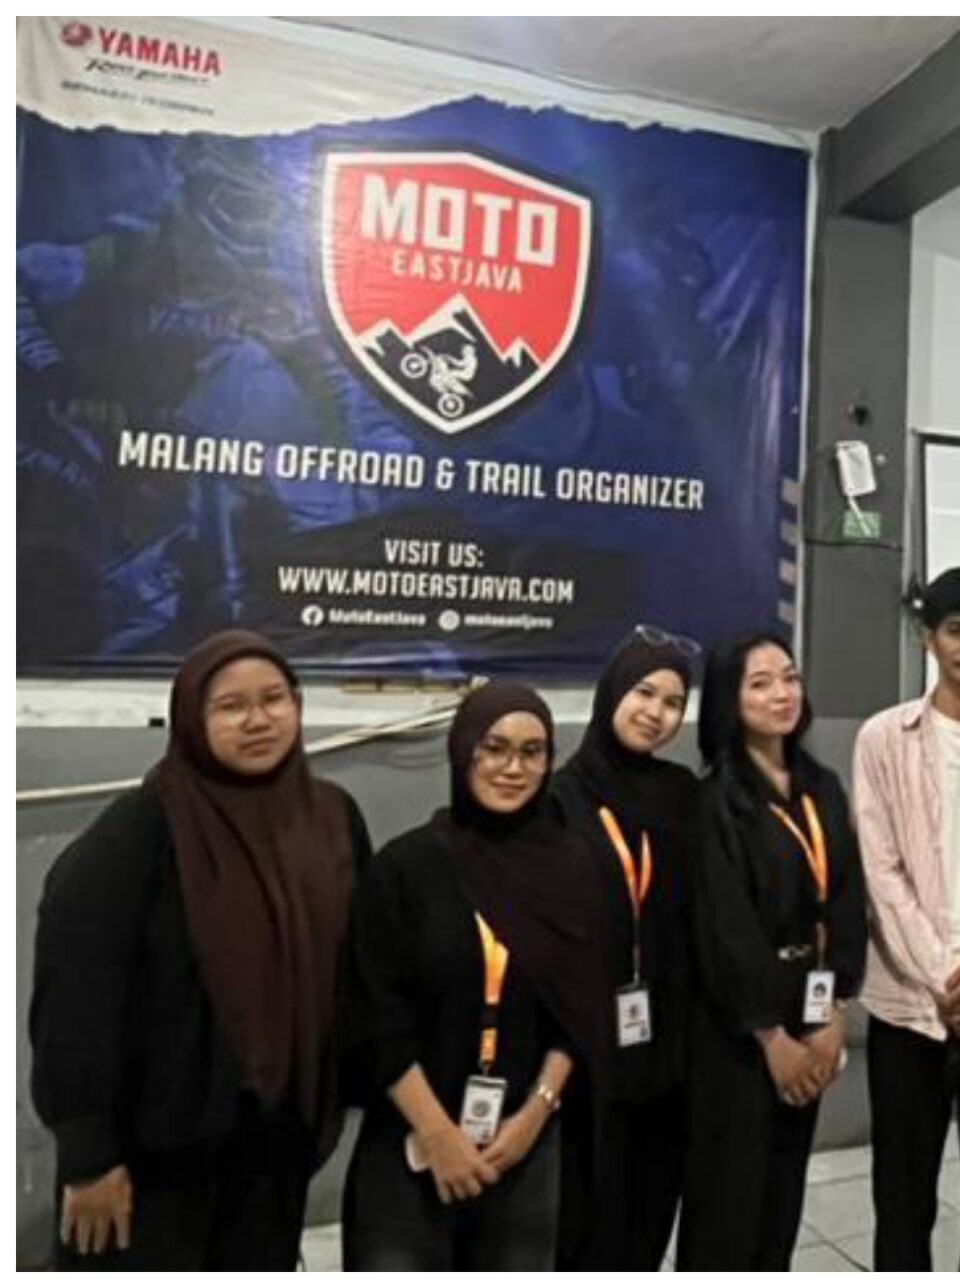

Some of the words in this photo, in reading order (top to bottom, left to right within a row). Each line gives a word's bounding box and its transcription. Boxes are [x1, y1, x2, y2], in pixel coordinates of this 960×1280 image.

[99, 26, 221, 76] YAMAHA
[360, 174, 557, 267] MOTO
[392, 249, 523, 293] EASTJAVA
[118, 429, 264, 477] MALANG
[275, 443, 424, 489] OFFROAD
[435, 457, 454, 490] &
[466, 459, 546, 498] TRAIL
[556, 468, 704, 510] ORGANIZER
[385, 539, 442, 565] VISIT
[448, 543, 484, 568] US:
[278, 566, 574, 603] WWW.MOTOEASTJAVA.COM
